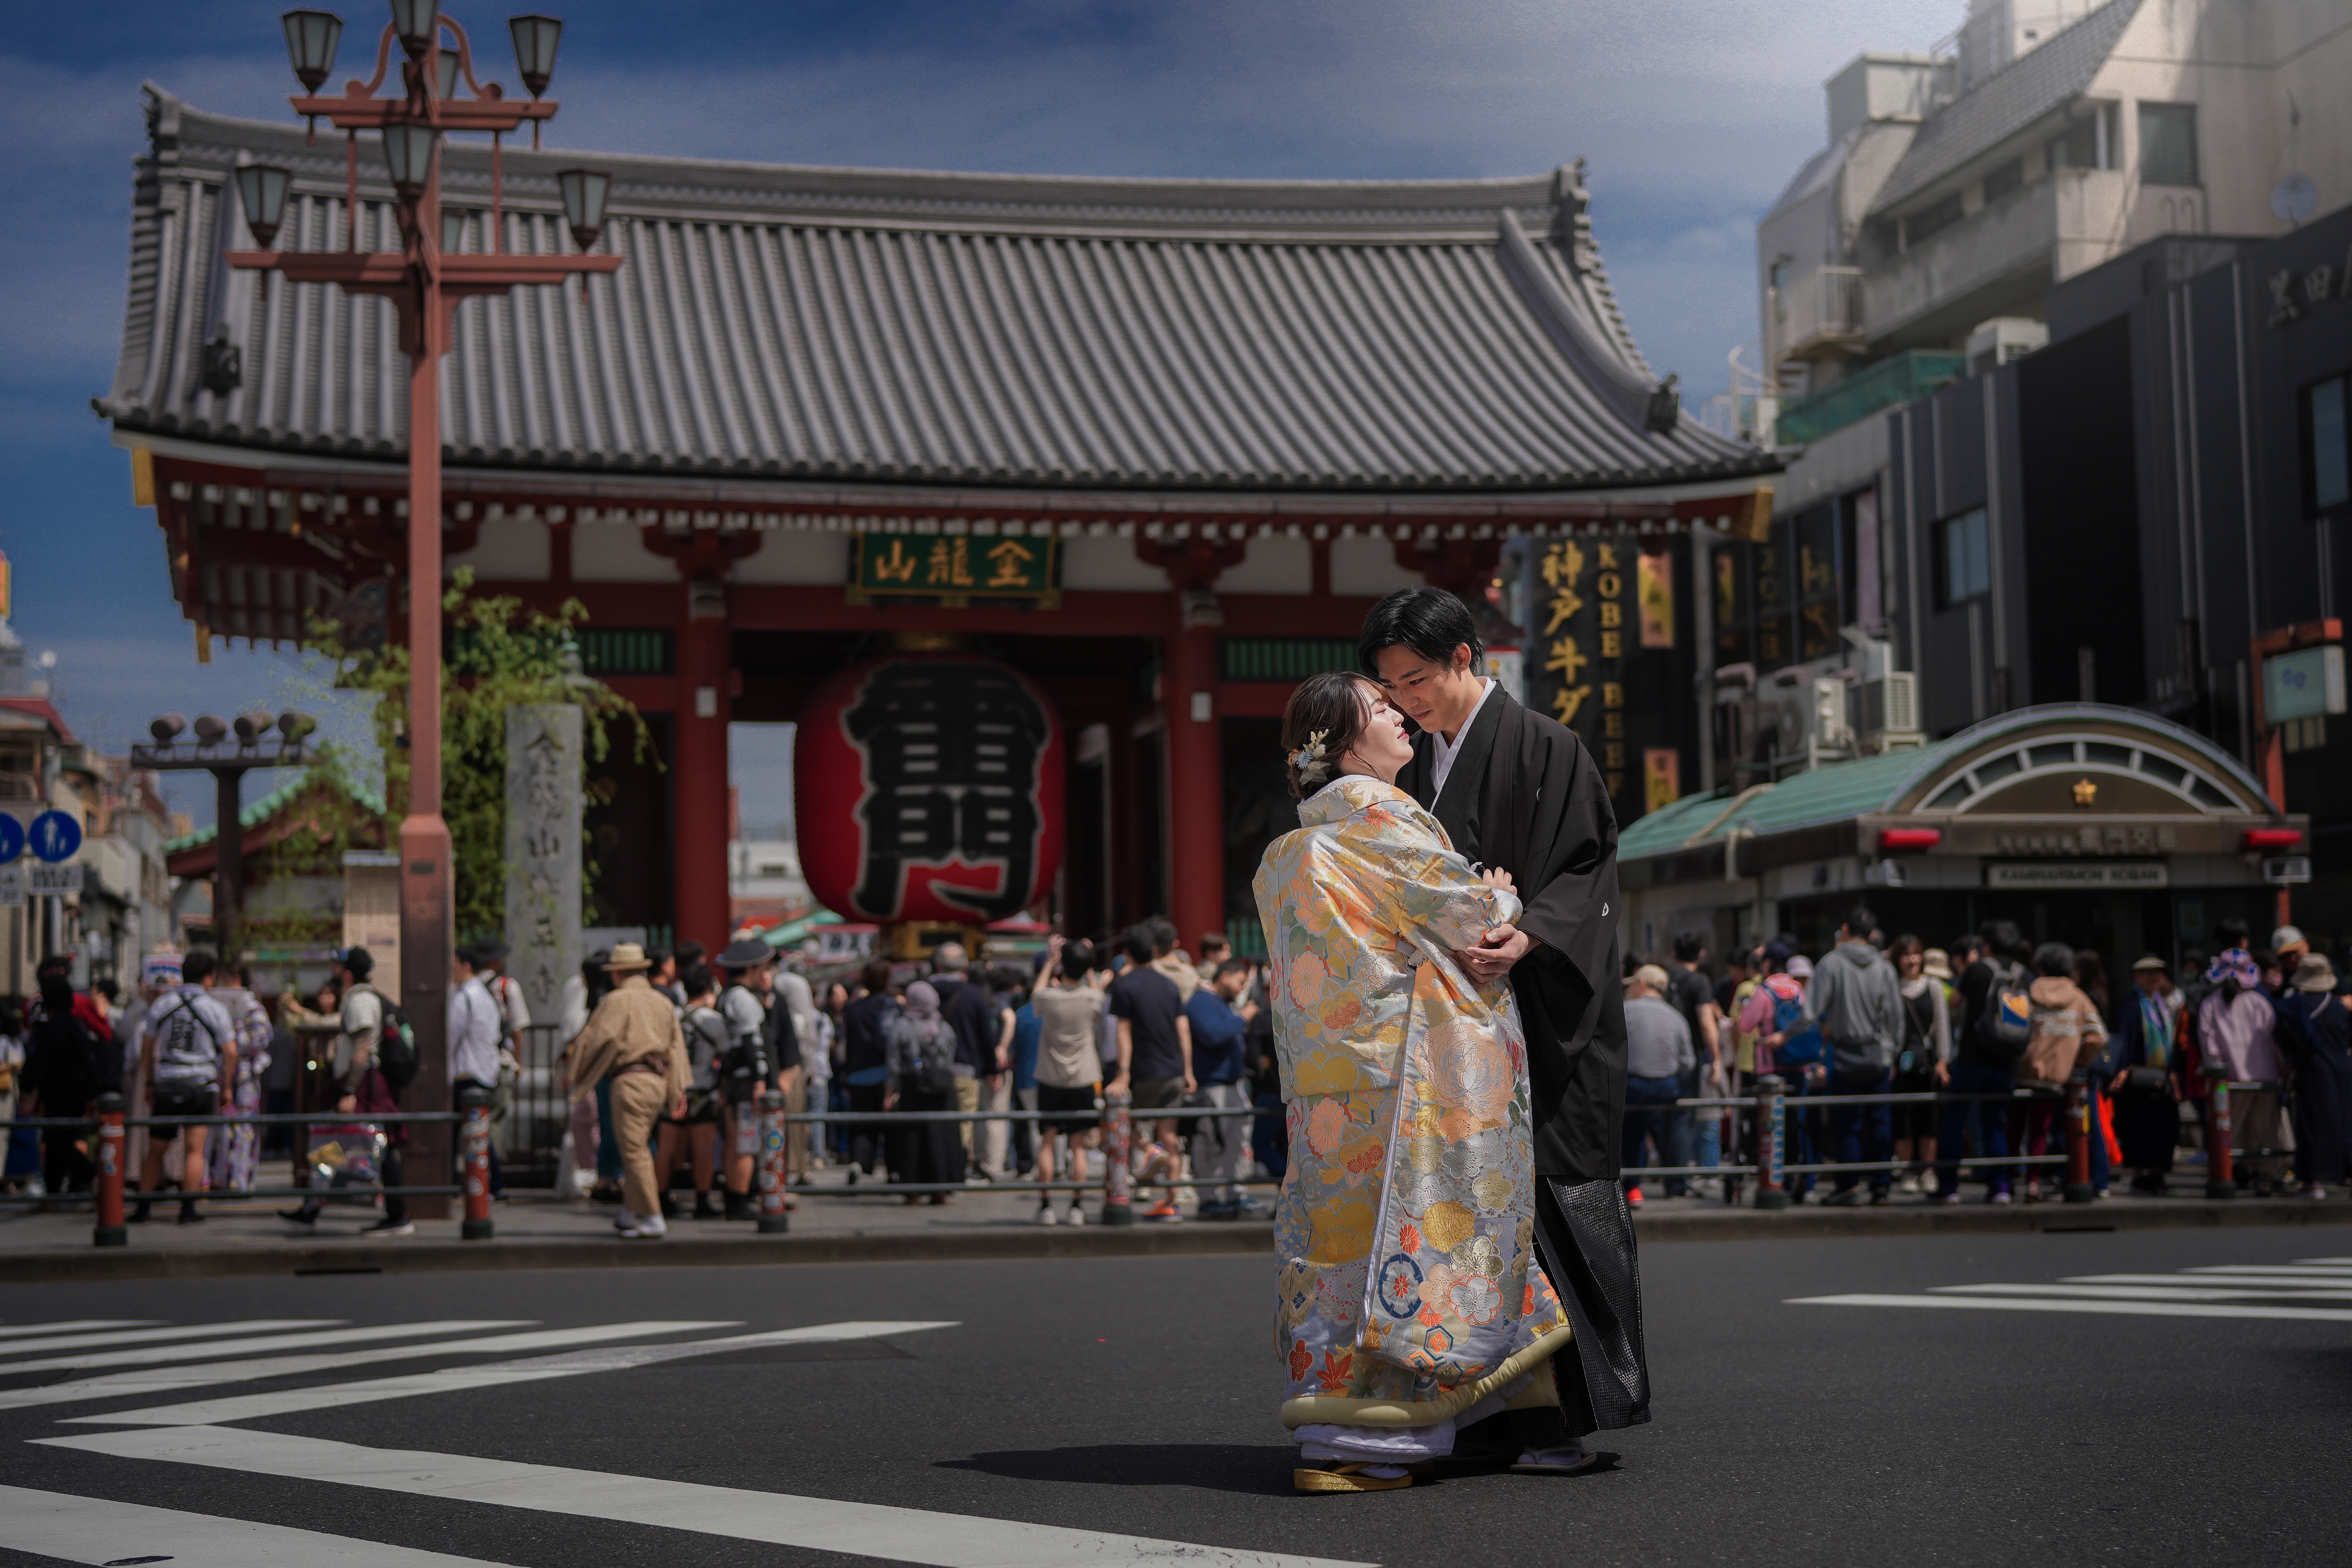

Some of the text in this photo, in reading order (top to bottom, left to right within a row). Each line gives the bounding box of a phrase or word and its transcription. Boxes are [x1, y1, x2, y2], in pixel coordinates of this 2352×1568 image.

[2267, 244, 2352, 330] 黒田
[1542, 540, 1592, 739] 神戸牛ダ
[1597, 541, 1625, 799] KOBE BEEF
